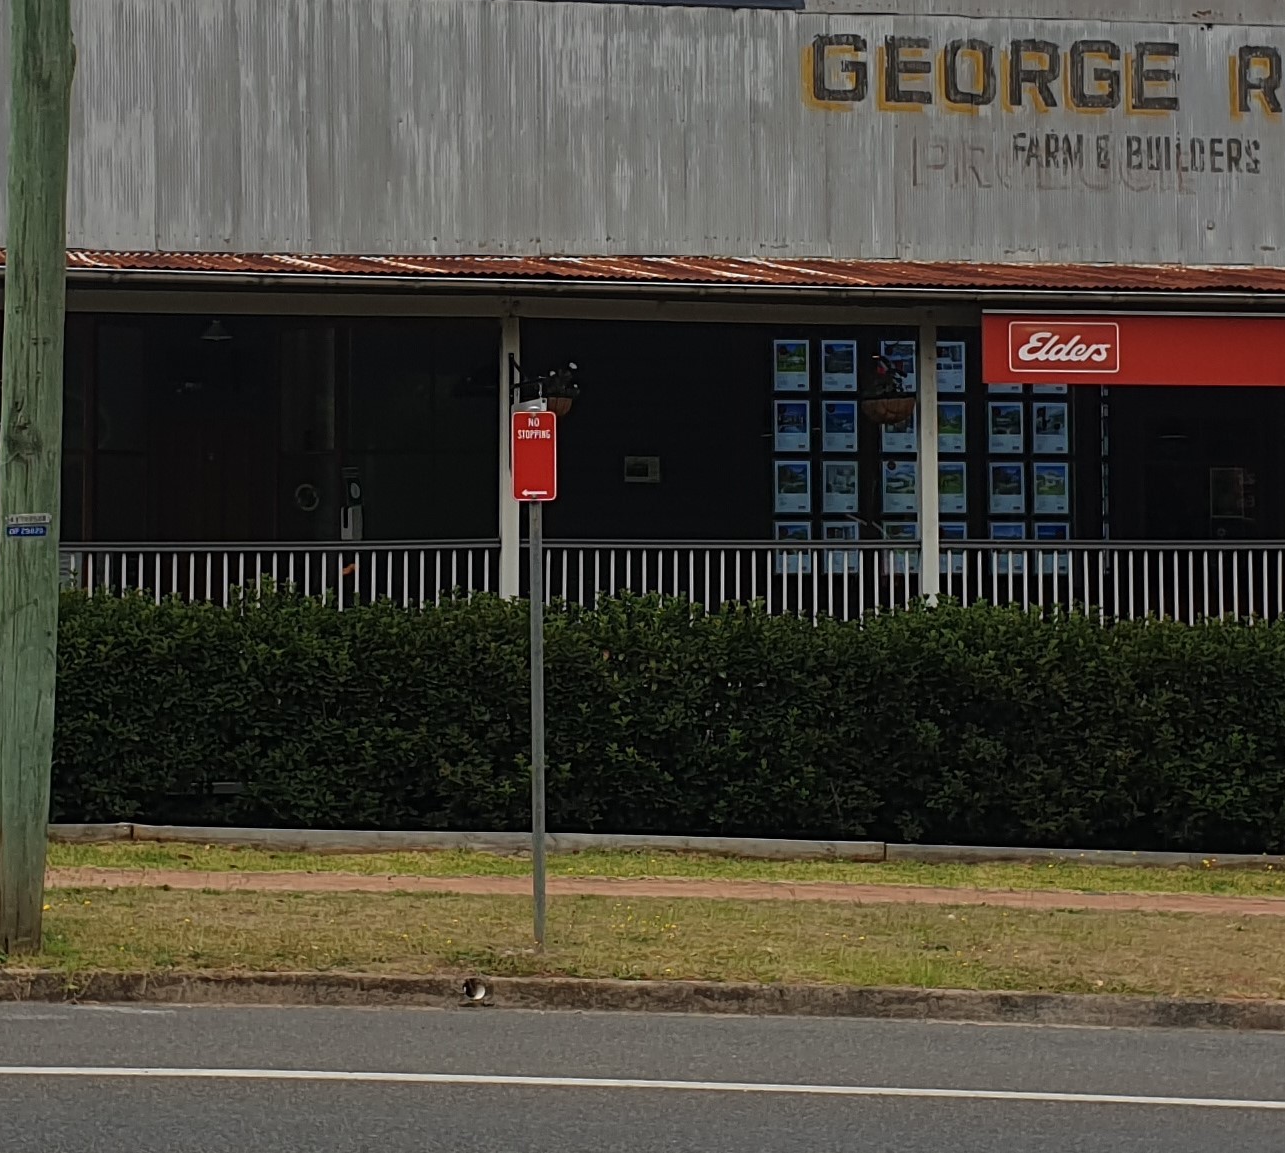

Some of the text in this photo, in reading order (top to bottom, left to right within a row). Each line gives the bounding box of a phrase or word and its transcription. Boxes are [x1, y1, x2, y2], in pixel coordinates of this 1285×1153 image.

[802, 34, 1180, 117] GEORGE
[1012, 132, 1084, 170] FARM
[1126, 134, 1261, 175] BUILDERS
[1018, 331, 1112, 362] Elders
[517, 429, 551, 440] STOPPING
[527, 417, 540, 427] NO
